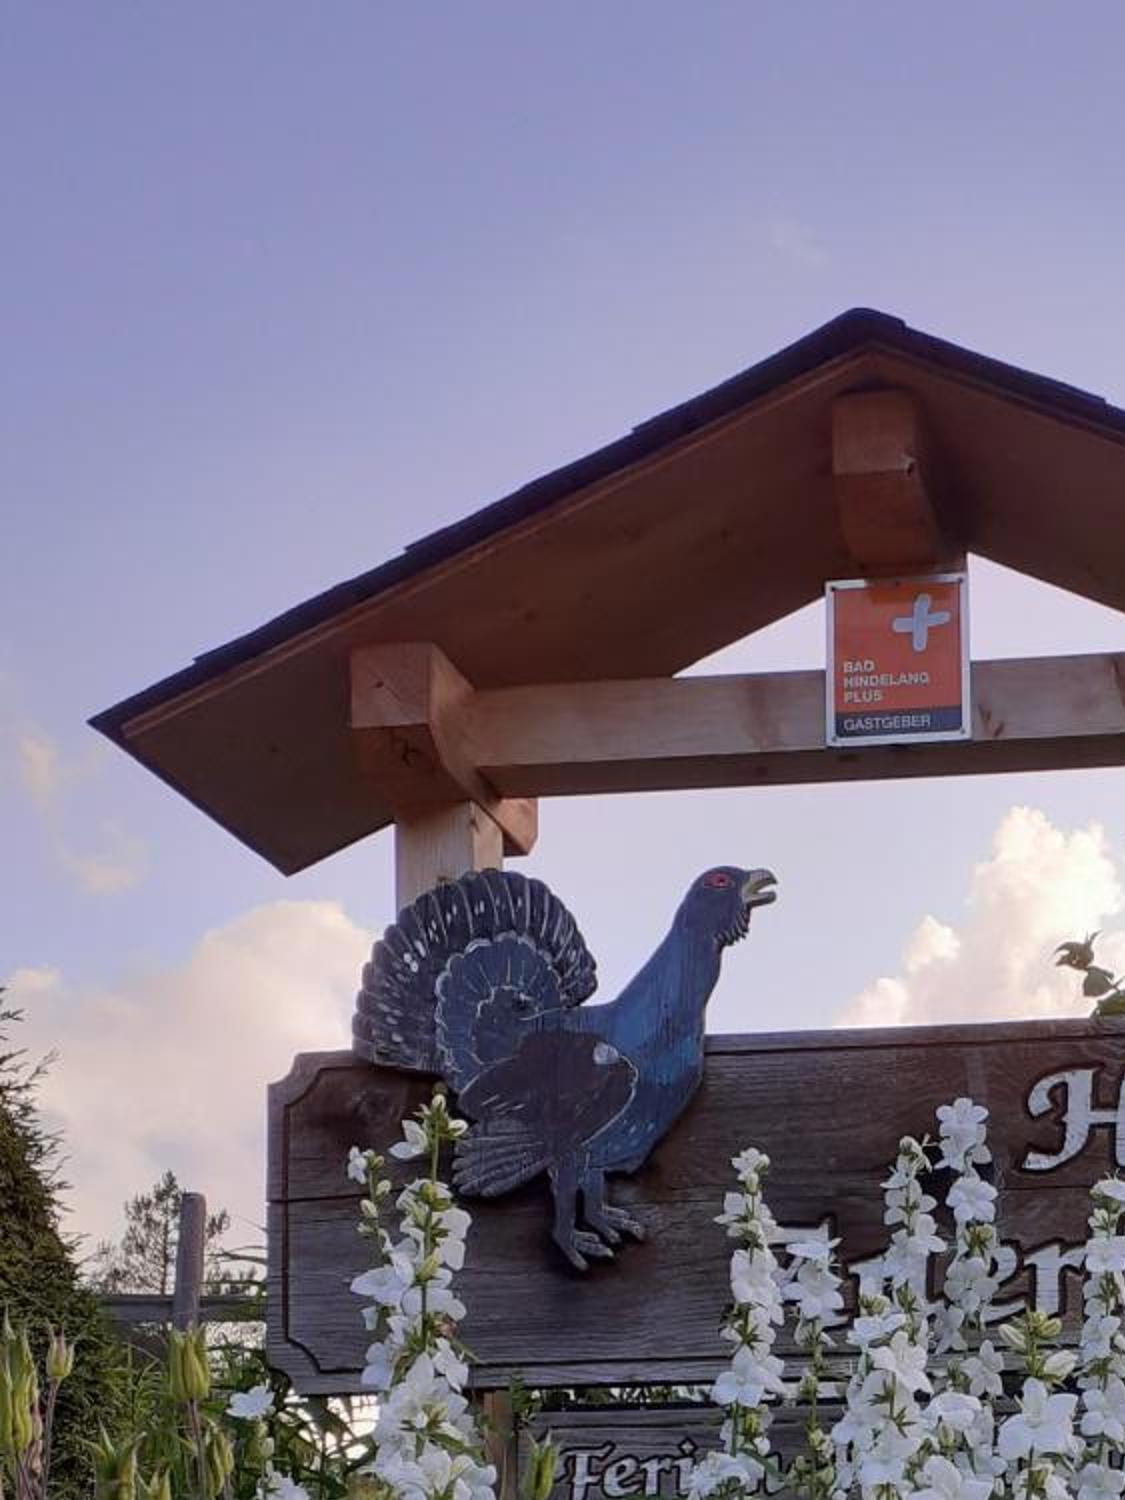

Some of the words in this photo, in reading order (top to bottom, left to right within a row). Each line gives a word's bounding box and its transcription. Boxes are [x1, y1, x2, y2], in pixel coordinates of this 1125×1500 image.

[842, 660, 875, 673] BAD
[842, 672, 929, 689] HINDELANG
[842, 690, 883, 703] PLUS
[842, 714, 932, 731] GASTGEBER
